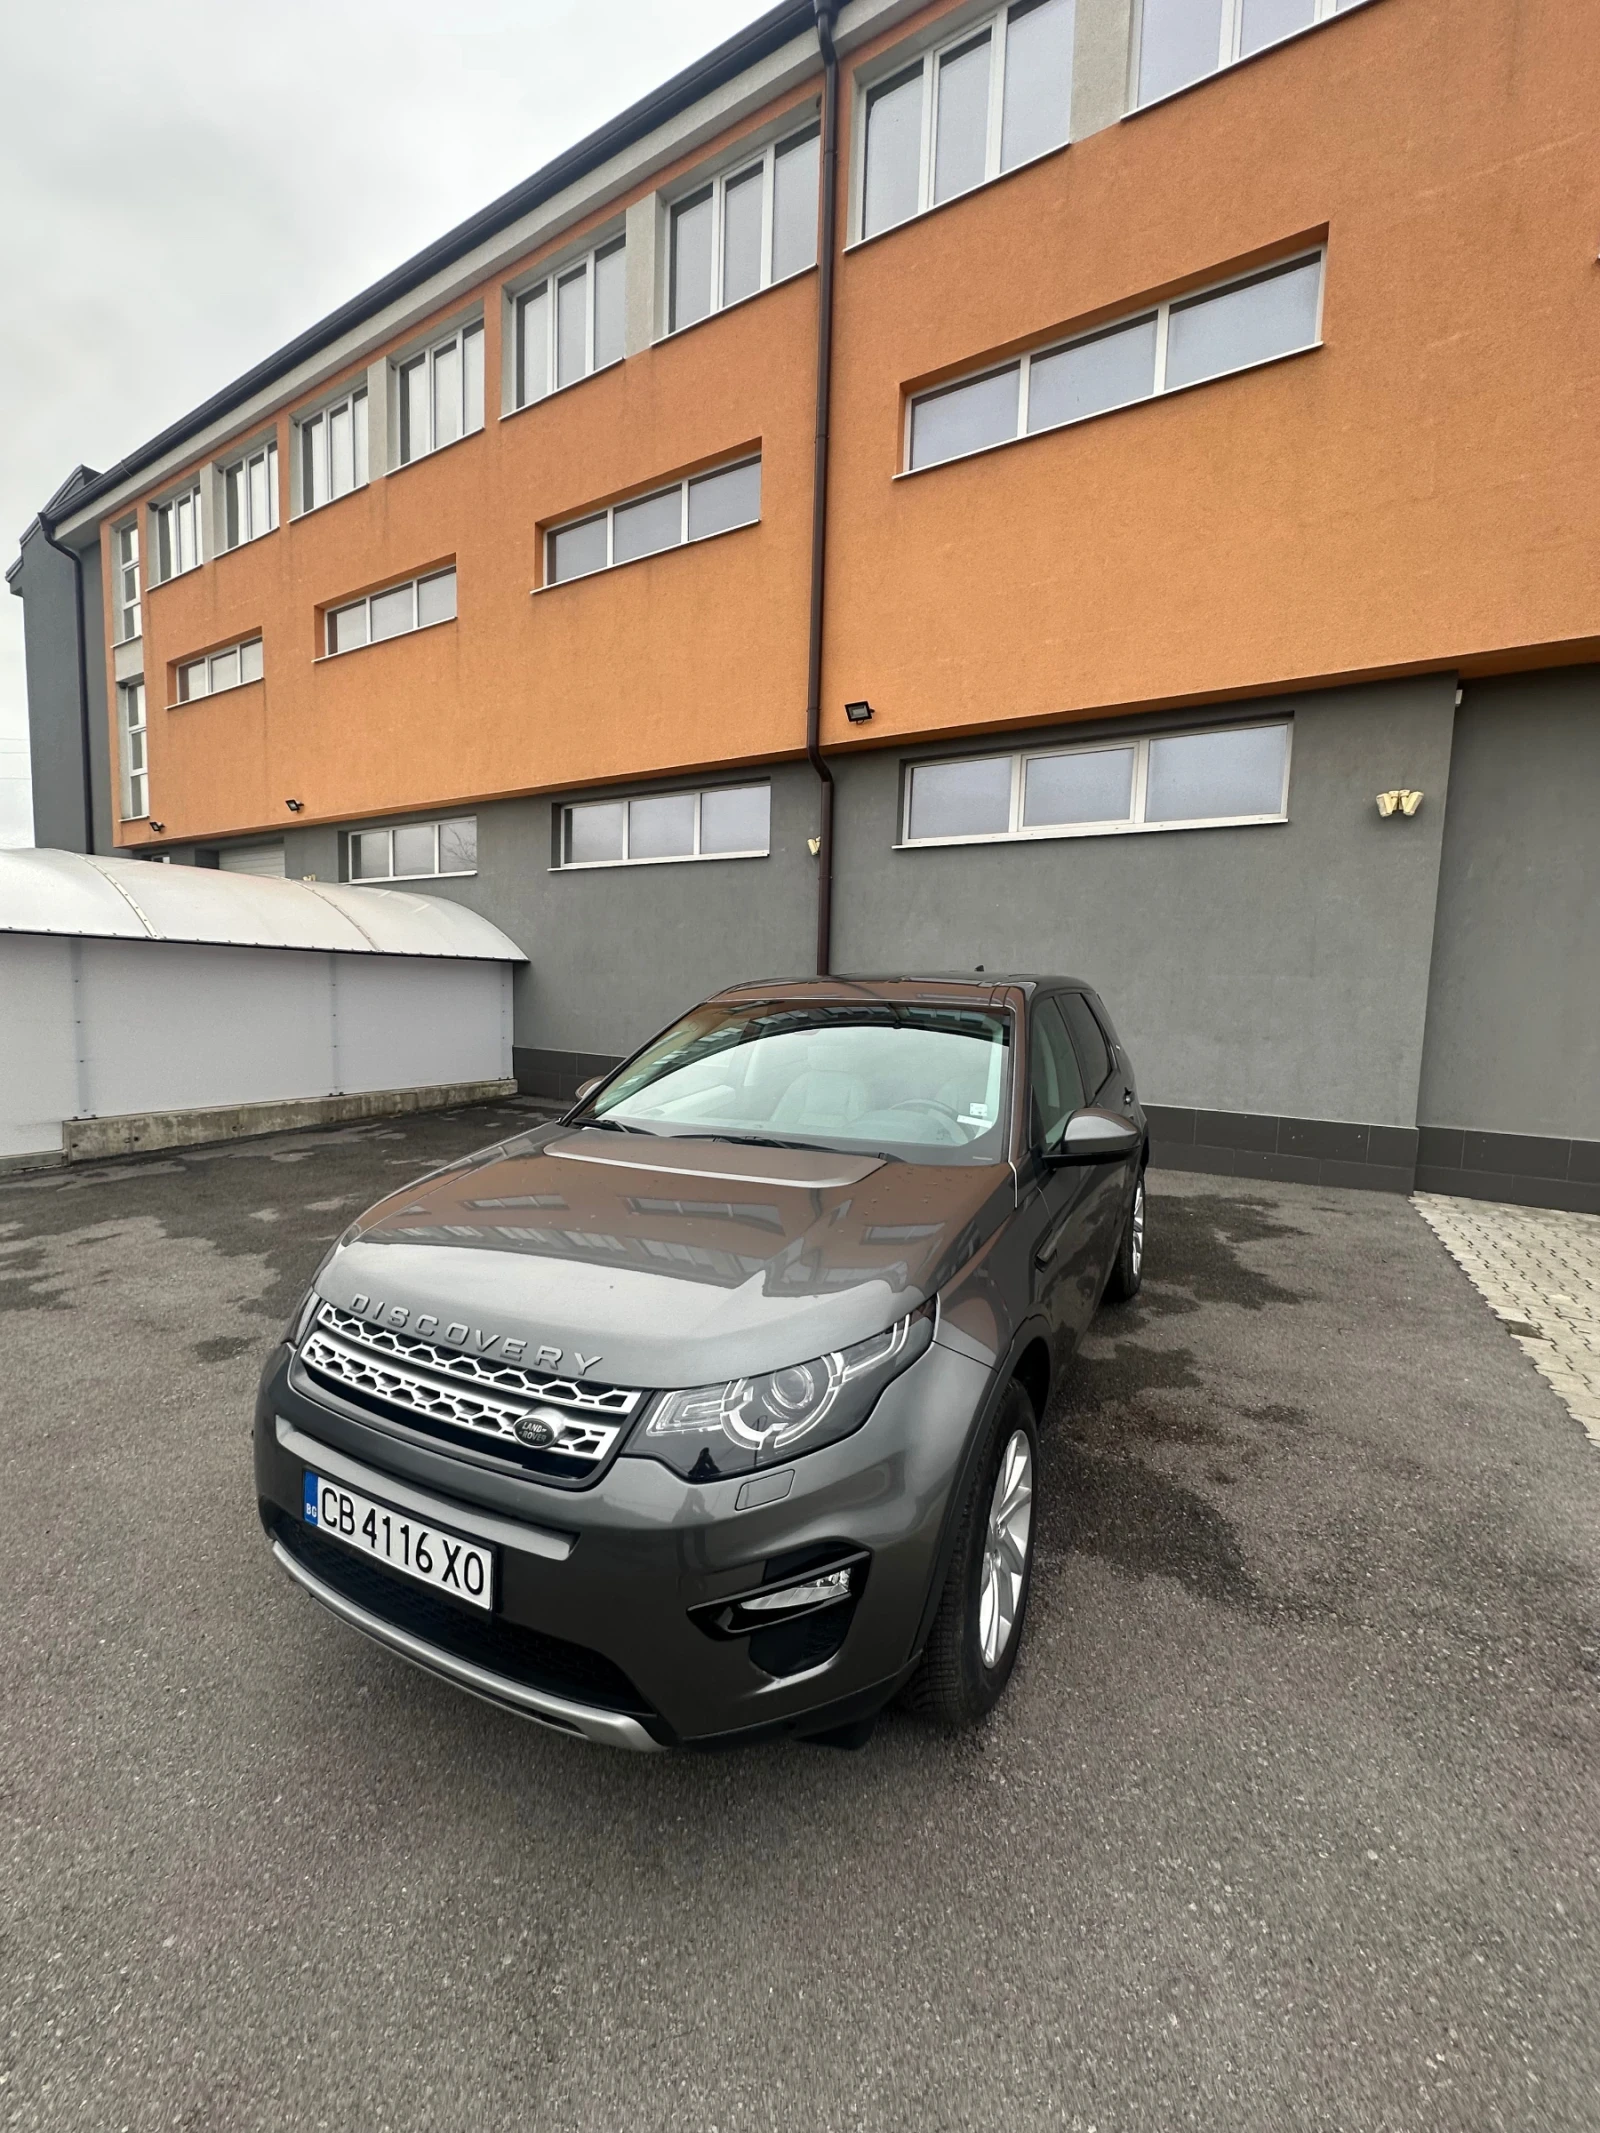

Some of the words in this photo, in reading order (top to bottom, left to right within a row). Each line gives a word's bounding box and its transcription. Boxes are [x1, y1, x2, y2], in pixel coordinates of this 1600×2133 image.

[349, 1293, 603, 1376] DISCOVERY
[521, 1421, 543, 1432] LAND
[521, 1430, 547, 1442] ROVER
[306, 1502, 317, 1518] BG
[322, 1487, 356, 1536] CB
[362, 1508, 434, 1574] 4116
[441, 1539, 485, 1596] XO
